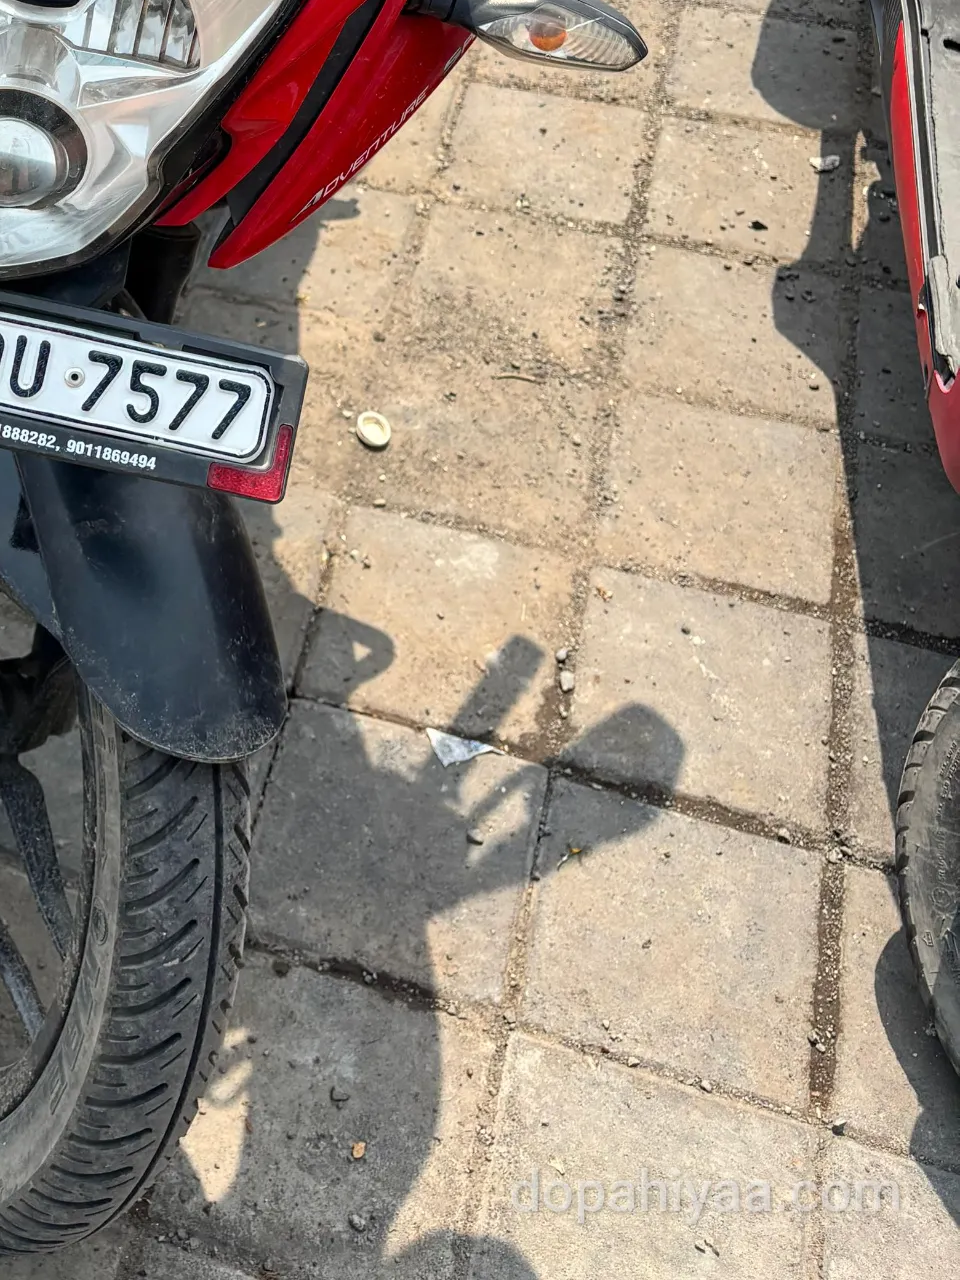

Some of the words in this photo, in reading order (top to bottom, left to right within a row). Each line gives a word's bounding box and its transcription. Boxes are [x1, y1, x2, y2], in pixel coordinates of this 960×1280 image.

[290, 85, 429, 222] ADVENTURE
[82, 350, 252, 440] 7577
[66, 439, 157, 470] 9011869494
